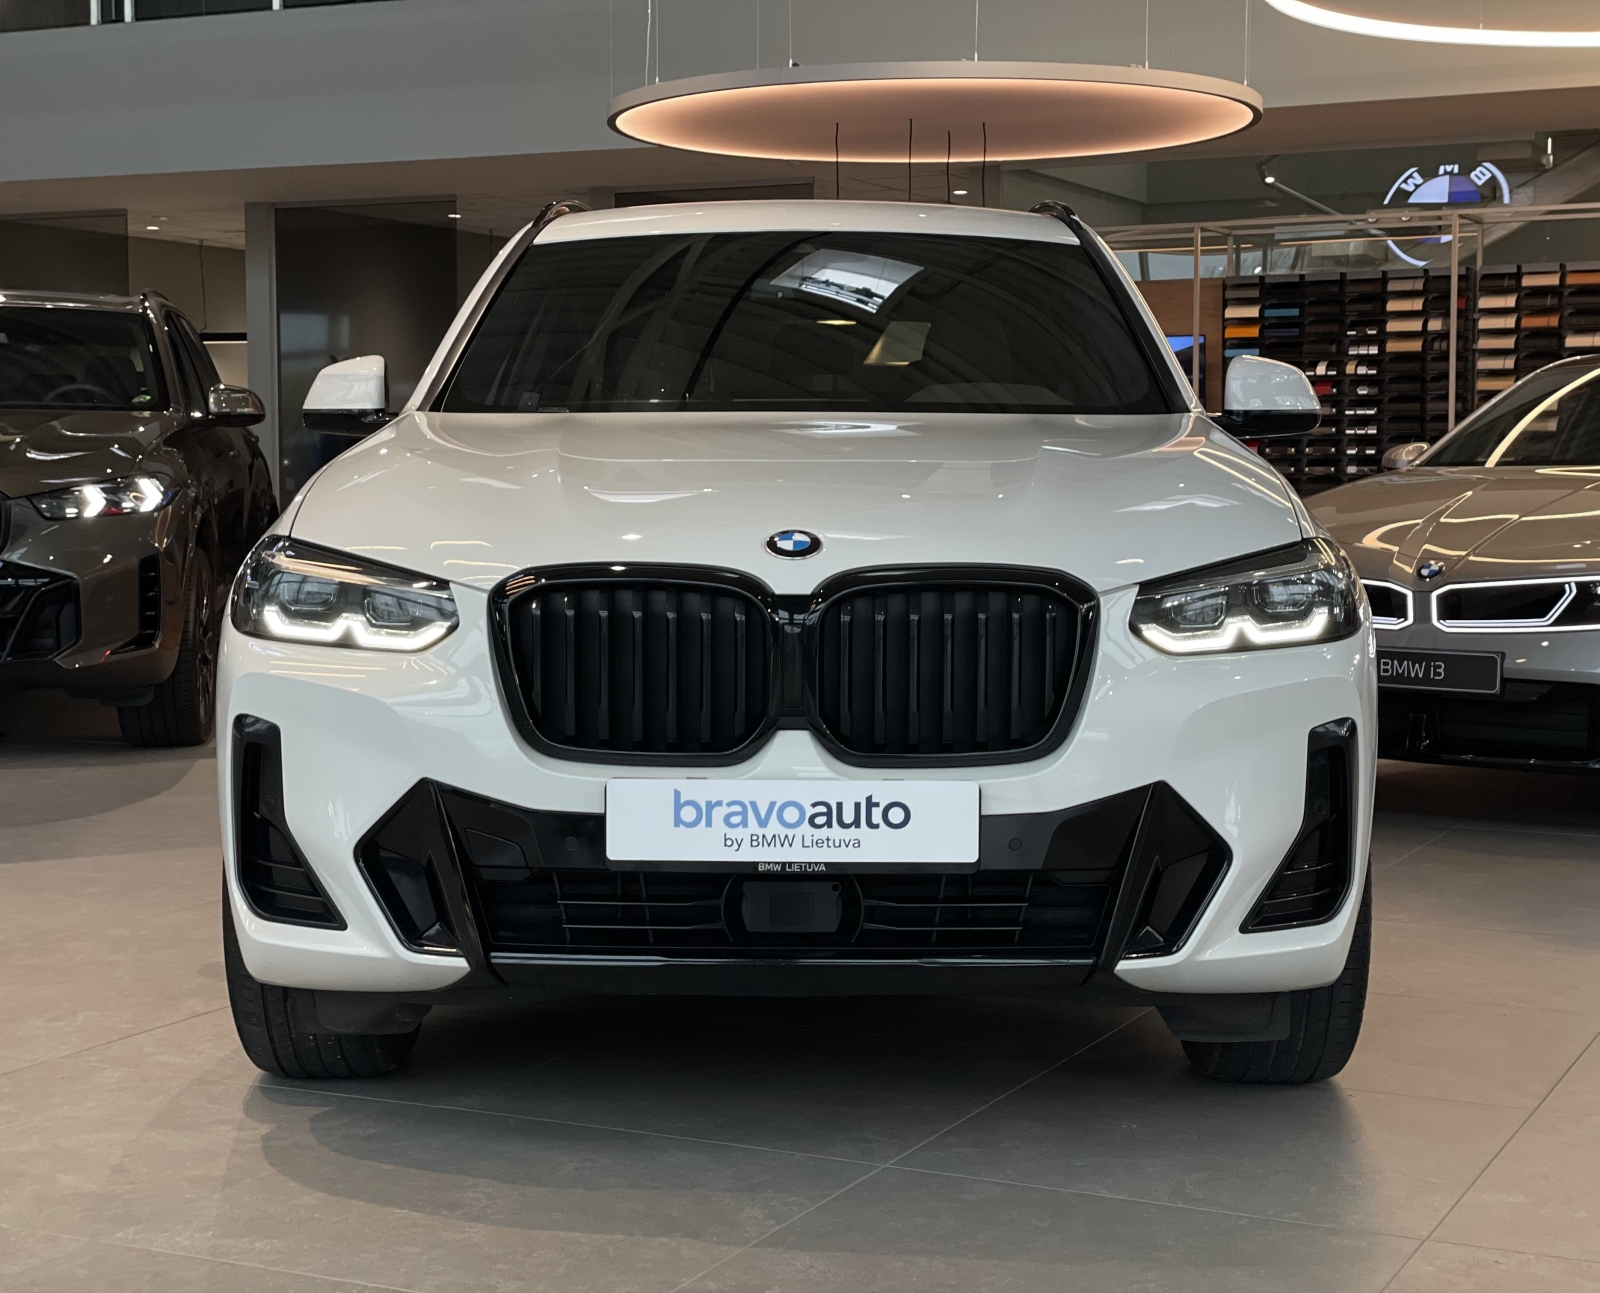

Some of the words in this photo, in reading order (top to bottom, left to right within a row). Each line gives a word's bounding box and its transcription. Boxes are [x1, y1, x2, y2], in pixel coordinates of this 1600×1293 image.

[1380, 659, 1426, 678] BMW
[1430, 662, 1445, 680] i3
[673, 788, 911, 830] bravoauto
[723, 833, 743, 851] by
[750, 834, 795, 848] BMW
[801, 834, 861, 849] Lietuva
[758, 862, 782, 872] BMW
[786, 862, 826, 872] LIETUVA
